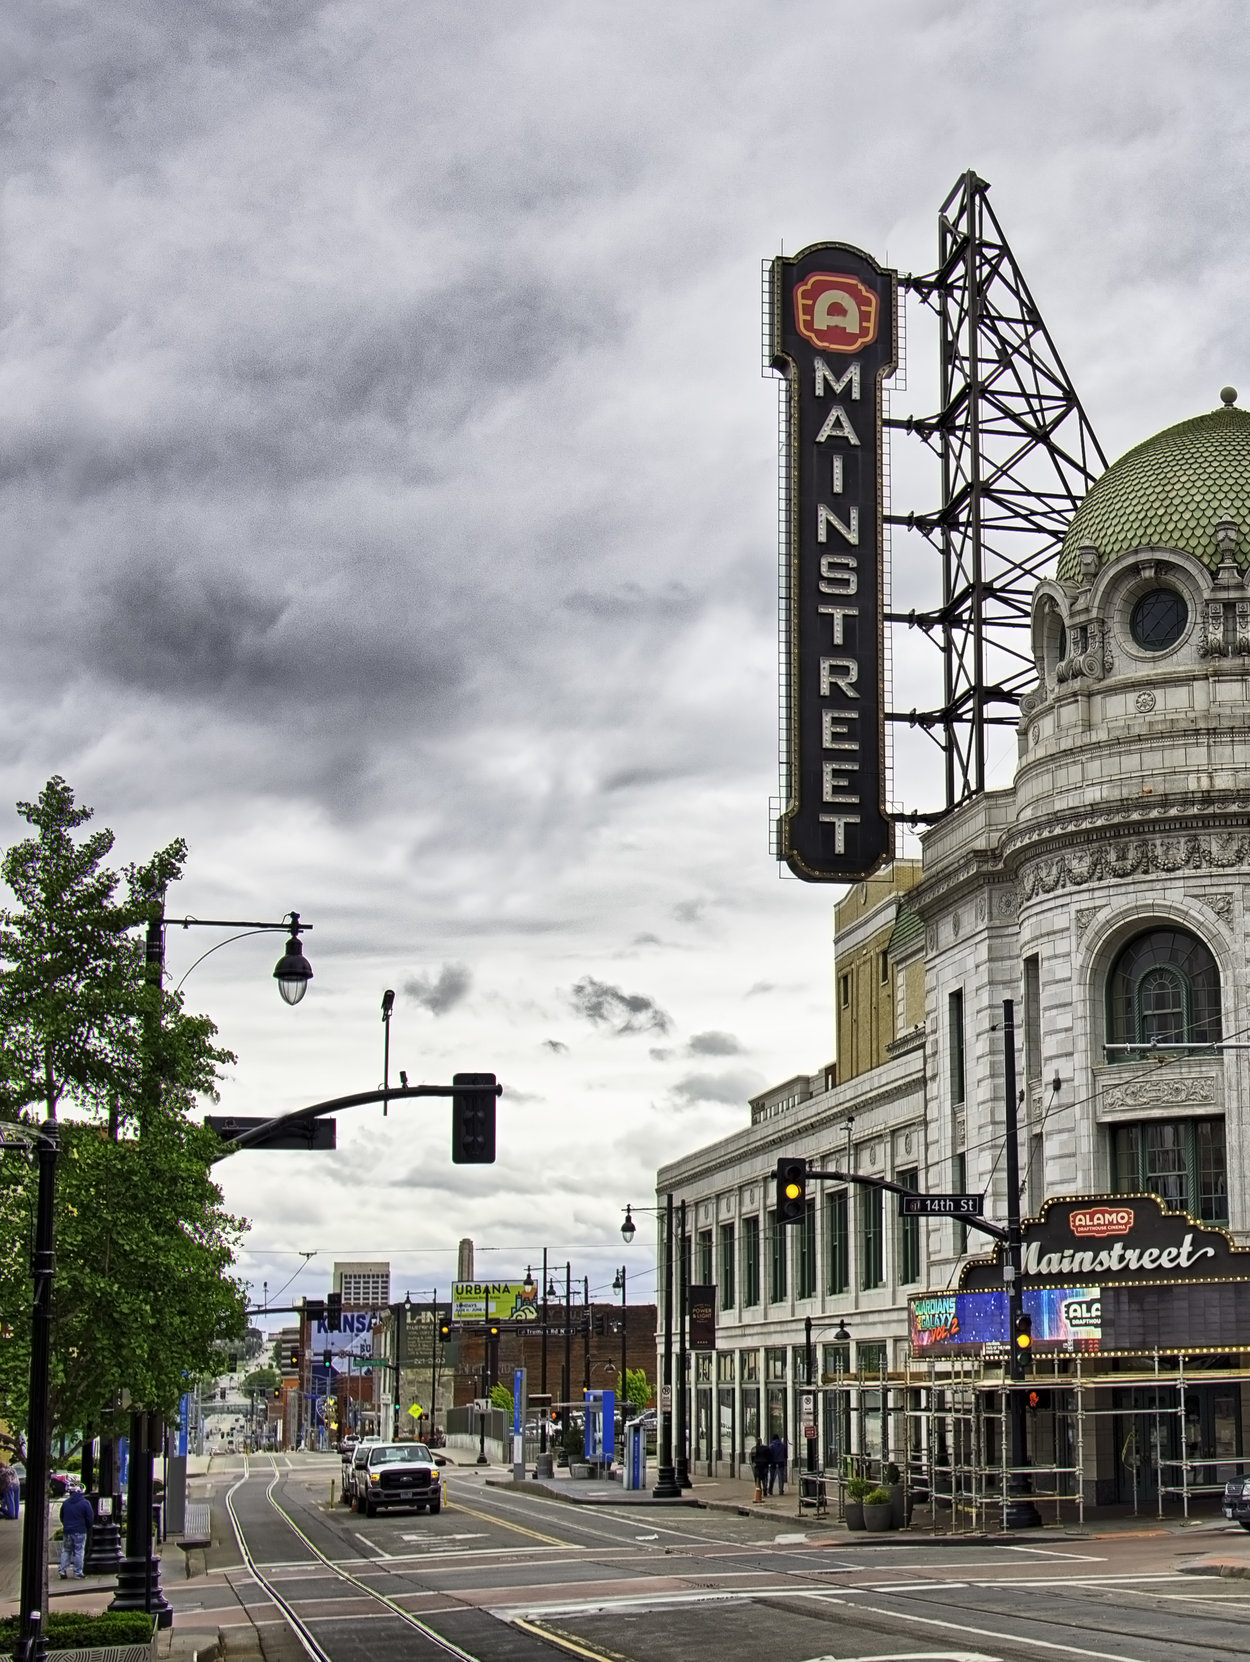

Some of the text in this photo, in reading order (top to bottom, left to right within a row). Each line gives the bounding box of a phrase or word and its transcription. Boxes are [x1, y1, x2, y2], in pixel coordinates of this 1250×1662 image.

[814, 356, 861, 855] MAINSTREET
[926, 1199, 974, 1211] 14th St
[1075, 1212, 1129, 1226] ALAMO
[1021, 1234, 1215, 1275] Mainstreet
[456, 1283, 511, 1295] URBANA
[914, 1297, 956, 1315] GUARDIANS
